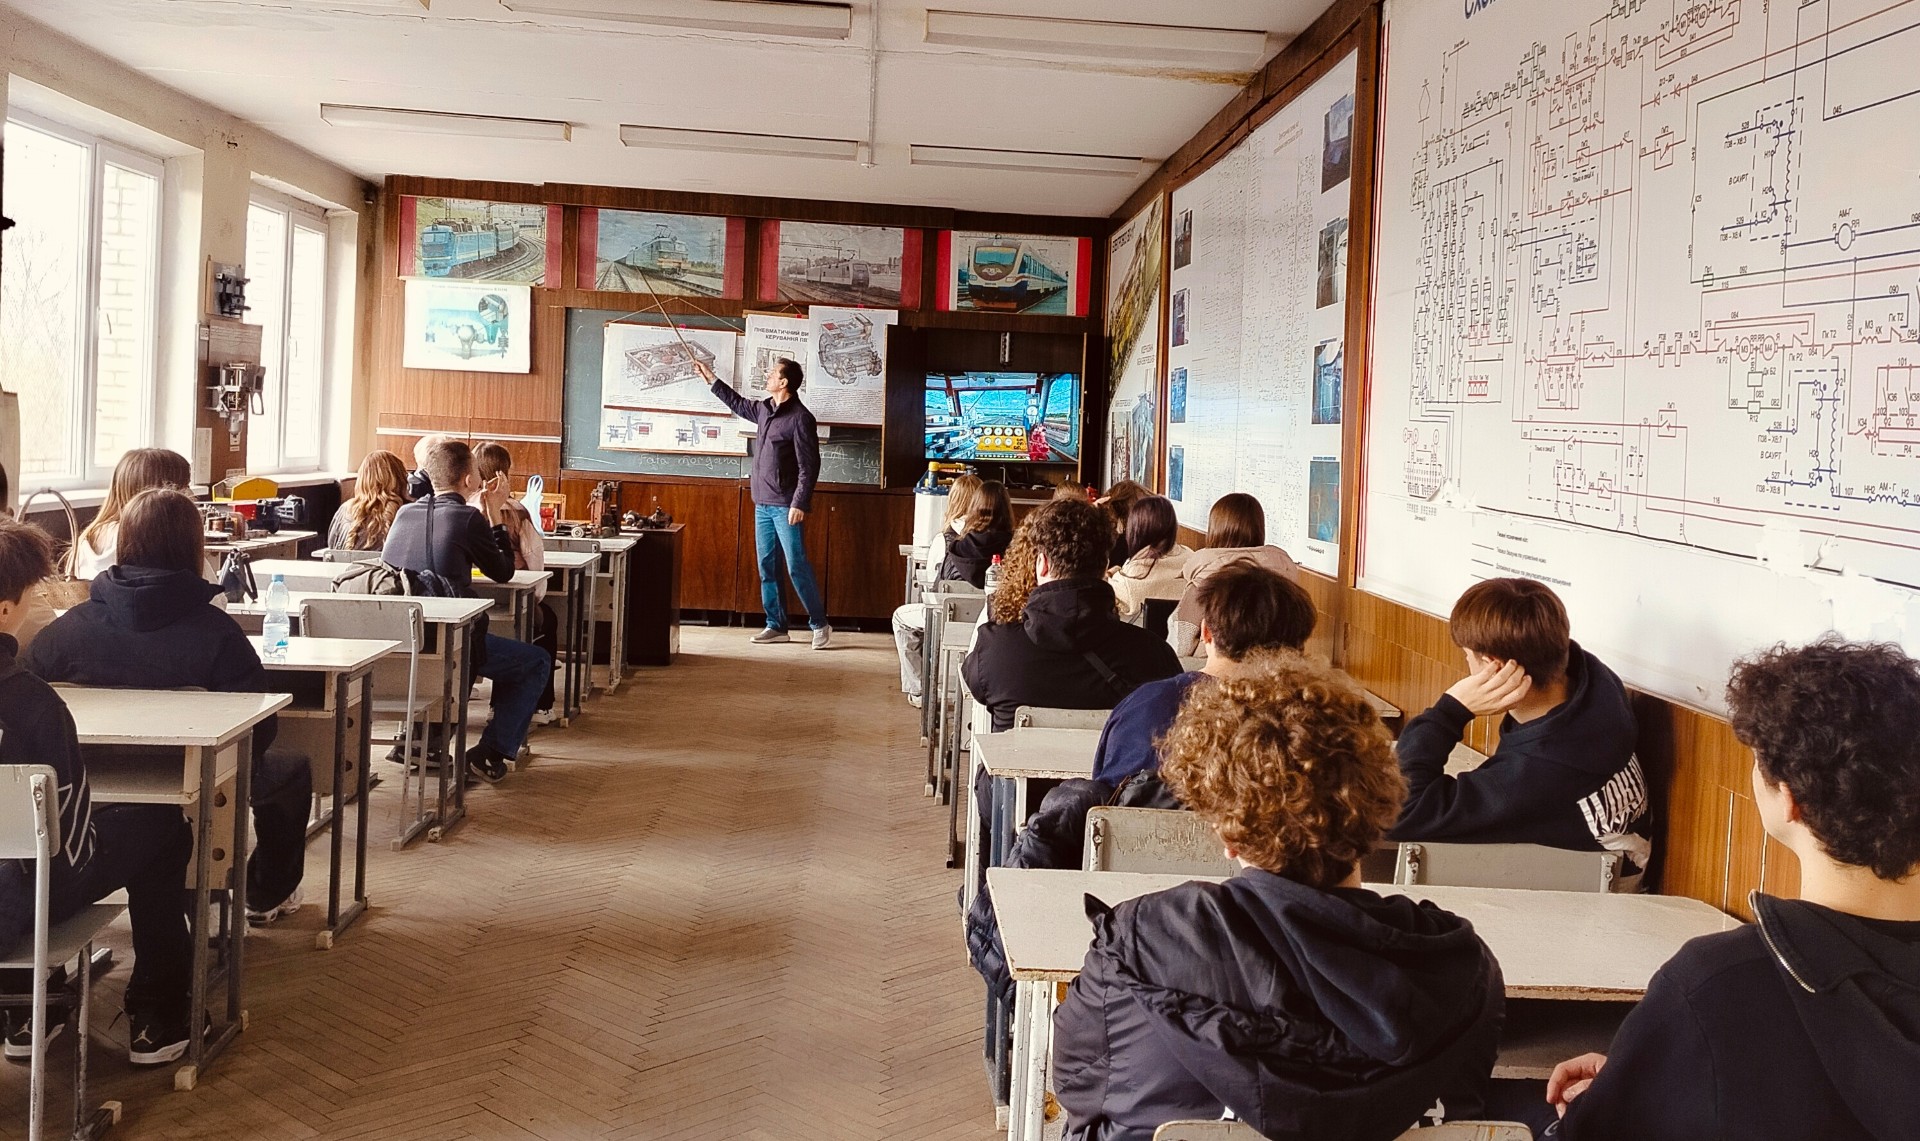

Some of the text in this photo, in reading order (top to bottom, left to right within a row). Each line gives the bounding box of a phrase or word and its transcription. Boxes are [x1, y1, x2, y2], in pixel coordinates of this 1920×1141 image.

[1889, 285, 1899, 294] 090
[1896, 312, 1904, 321] Т2
[1864, 320, 1874, 330] М3
[754, 327, 800, 336] ПНЕВМАТИЧНИЙ
[1741, 345, 1749, 353] М3
[1764, 343, 1773, 352] М4
[1898, 357, 1907, 366] 101
[1764, 451, 1782, 460] САУРТ
[1901, 489, 1910, 498] Н2
